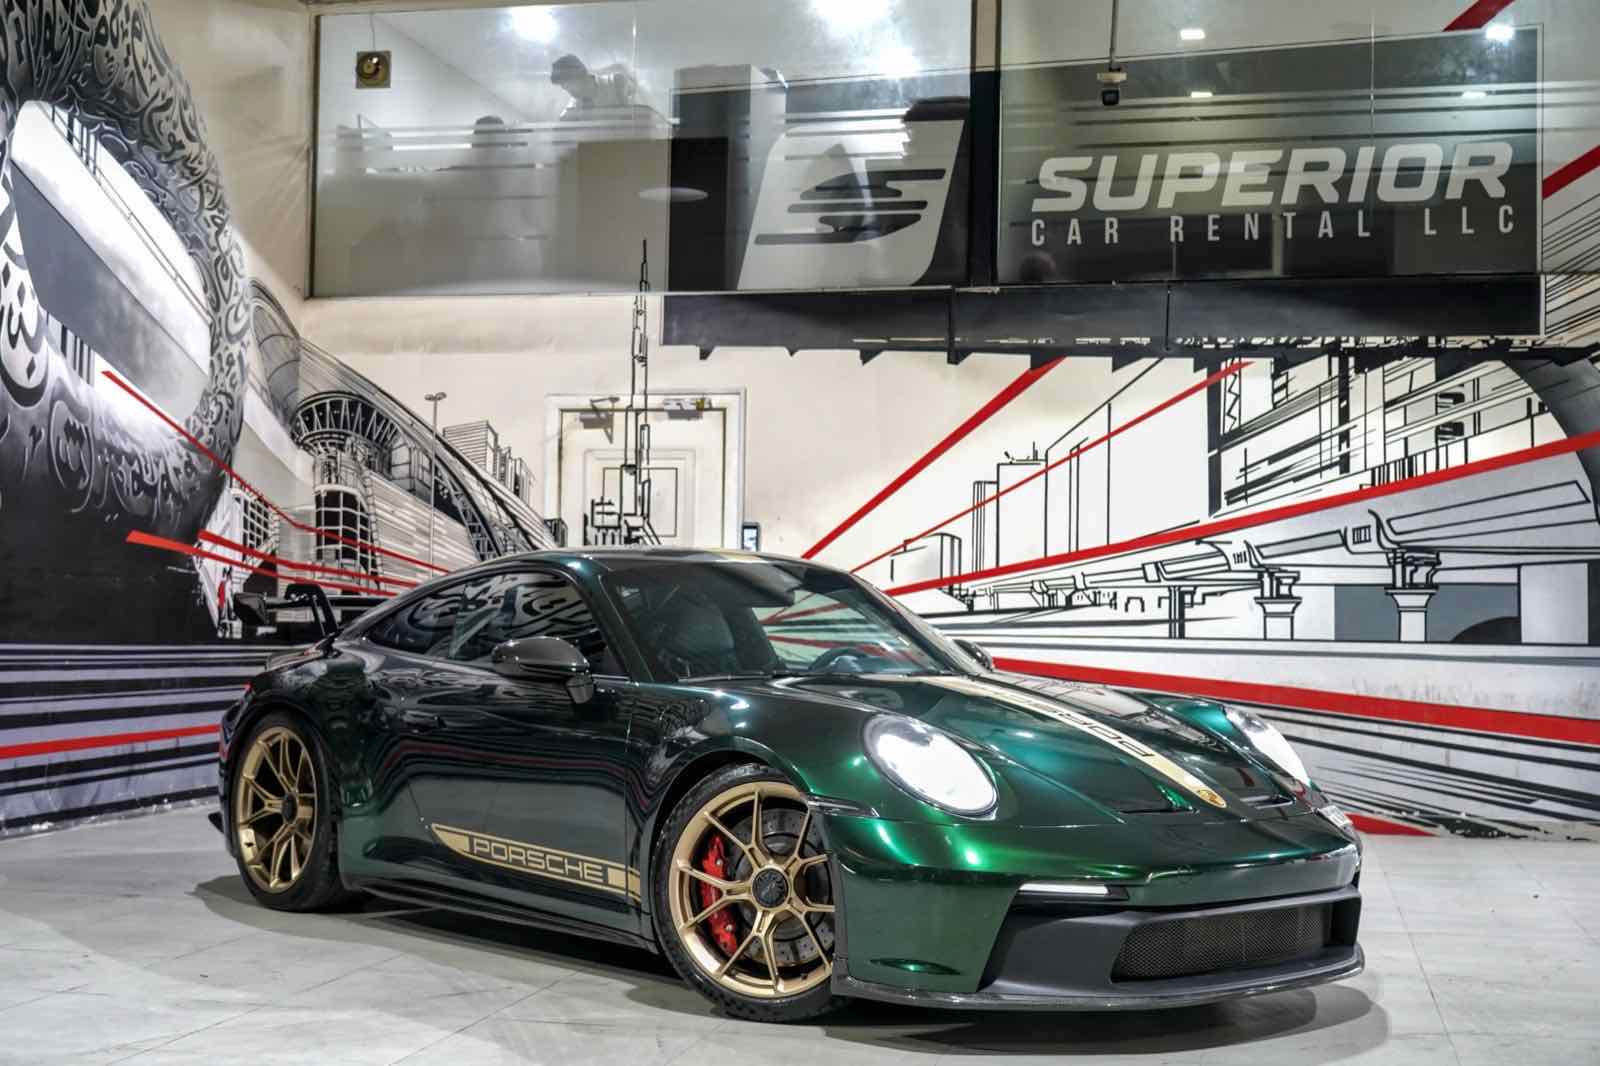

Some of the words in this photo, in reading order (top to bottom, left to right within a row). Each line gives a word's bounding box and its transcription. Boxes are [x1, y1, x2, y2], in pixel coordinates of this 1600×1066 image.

[1031, 143, 1513, 212] SUPERIOR
[1031, 217, 1119, 246] CAR
[1169, 208, 1371, 243] RENTAL
[1424, 205, 1513, 236] LLC
[473, 839, 604, 883] PORSCHE
